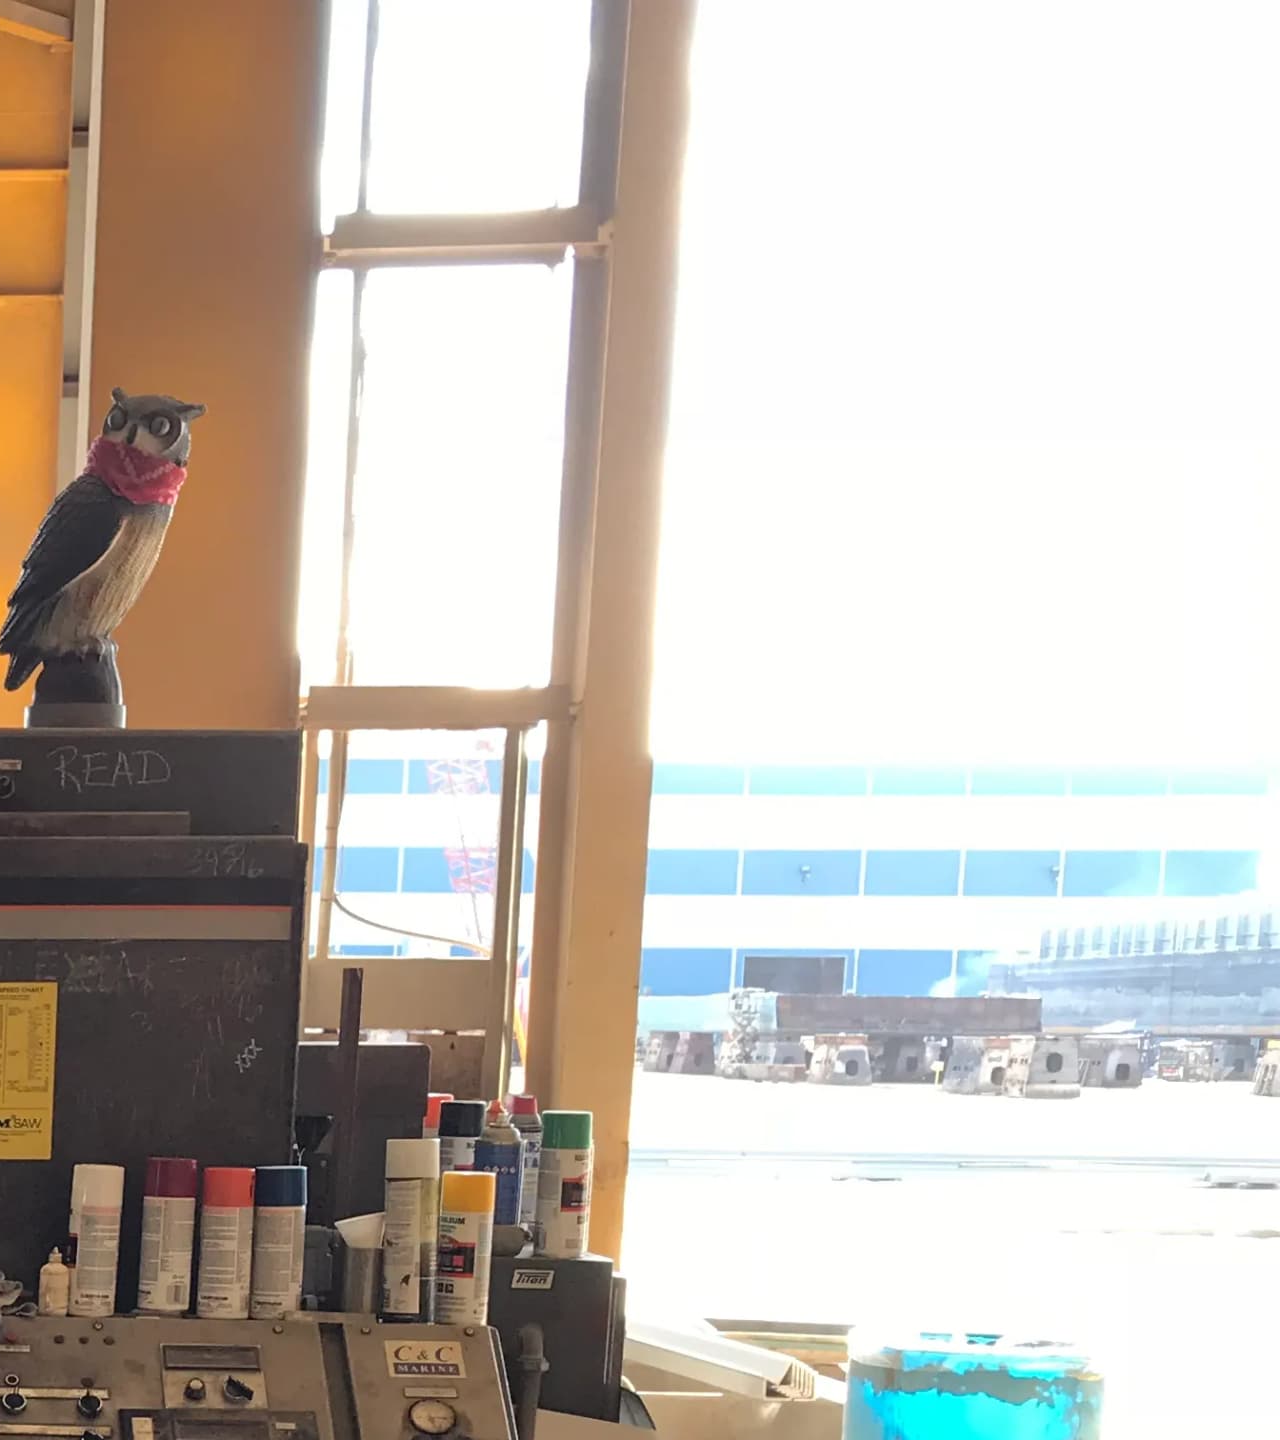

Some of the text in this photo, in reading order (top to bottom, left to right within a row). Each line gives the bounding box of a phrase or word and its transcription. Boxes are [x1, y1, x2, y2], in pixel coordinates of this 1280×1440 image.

[46, 745, 171, 793] READ
[13, 1118, 42, 1129] SAW
[394, 1345, 453, 1362] C & C
[398, 1364, 456, 1374] MARINE
